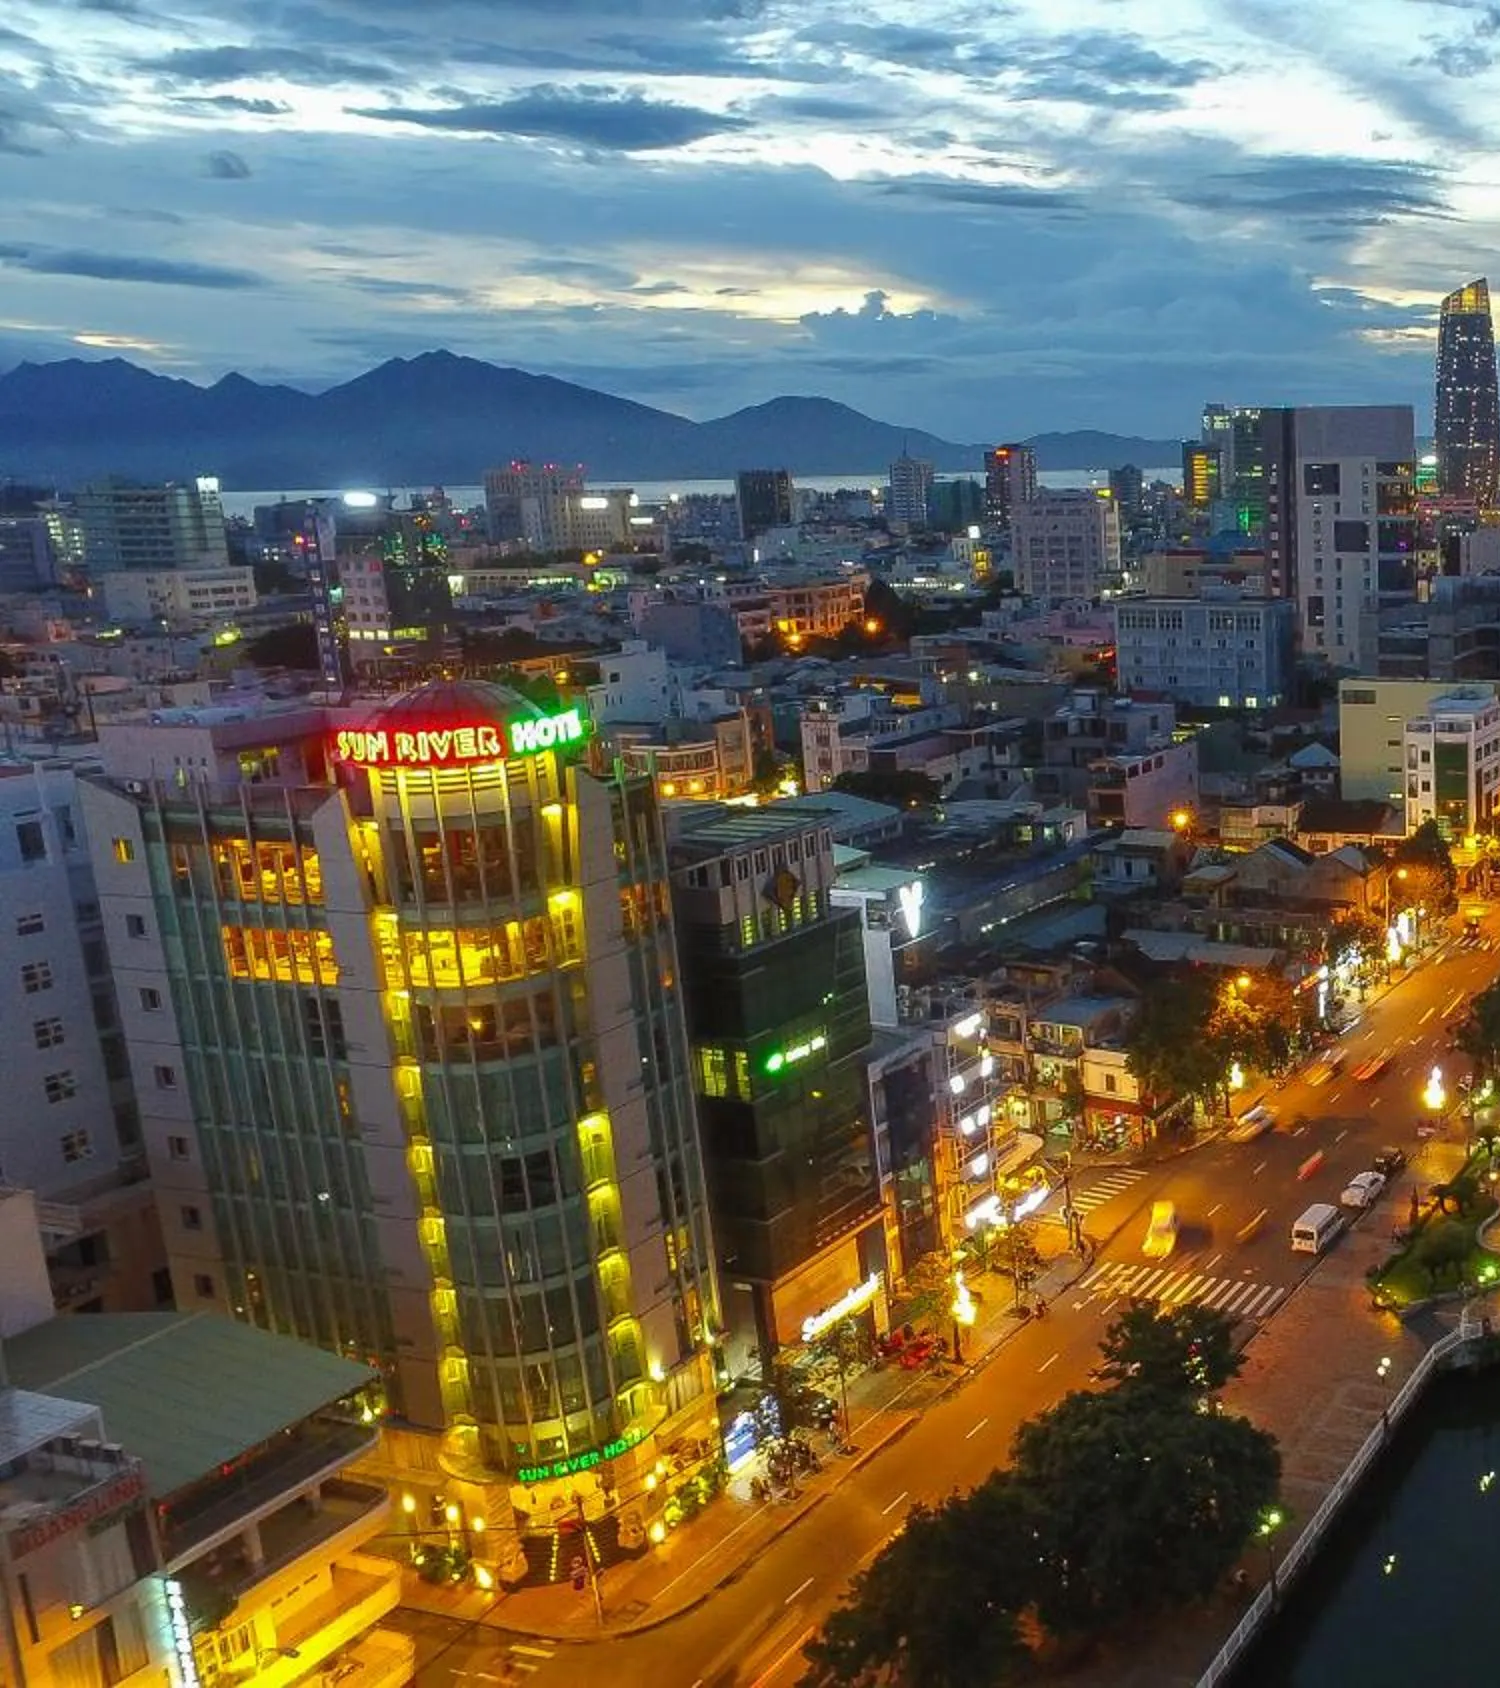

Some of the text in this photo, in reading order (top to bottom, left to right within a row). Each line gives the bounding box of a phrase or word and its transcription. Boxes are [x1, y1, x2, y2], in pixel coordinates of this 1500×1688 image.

[337, 731, 389, 762] SUN
[395, 727, 501, 762] RIVER
[518, 1466, 549, 1481] SUN
